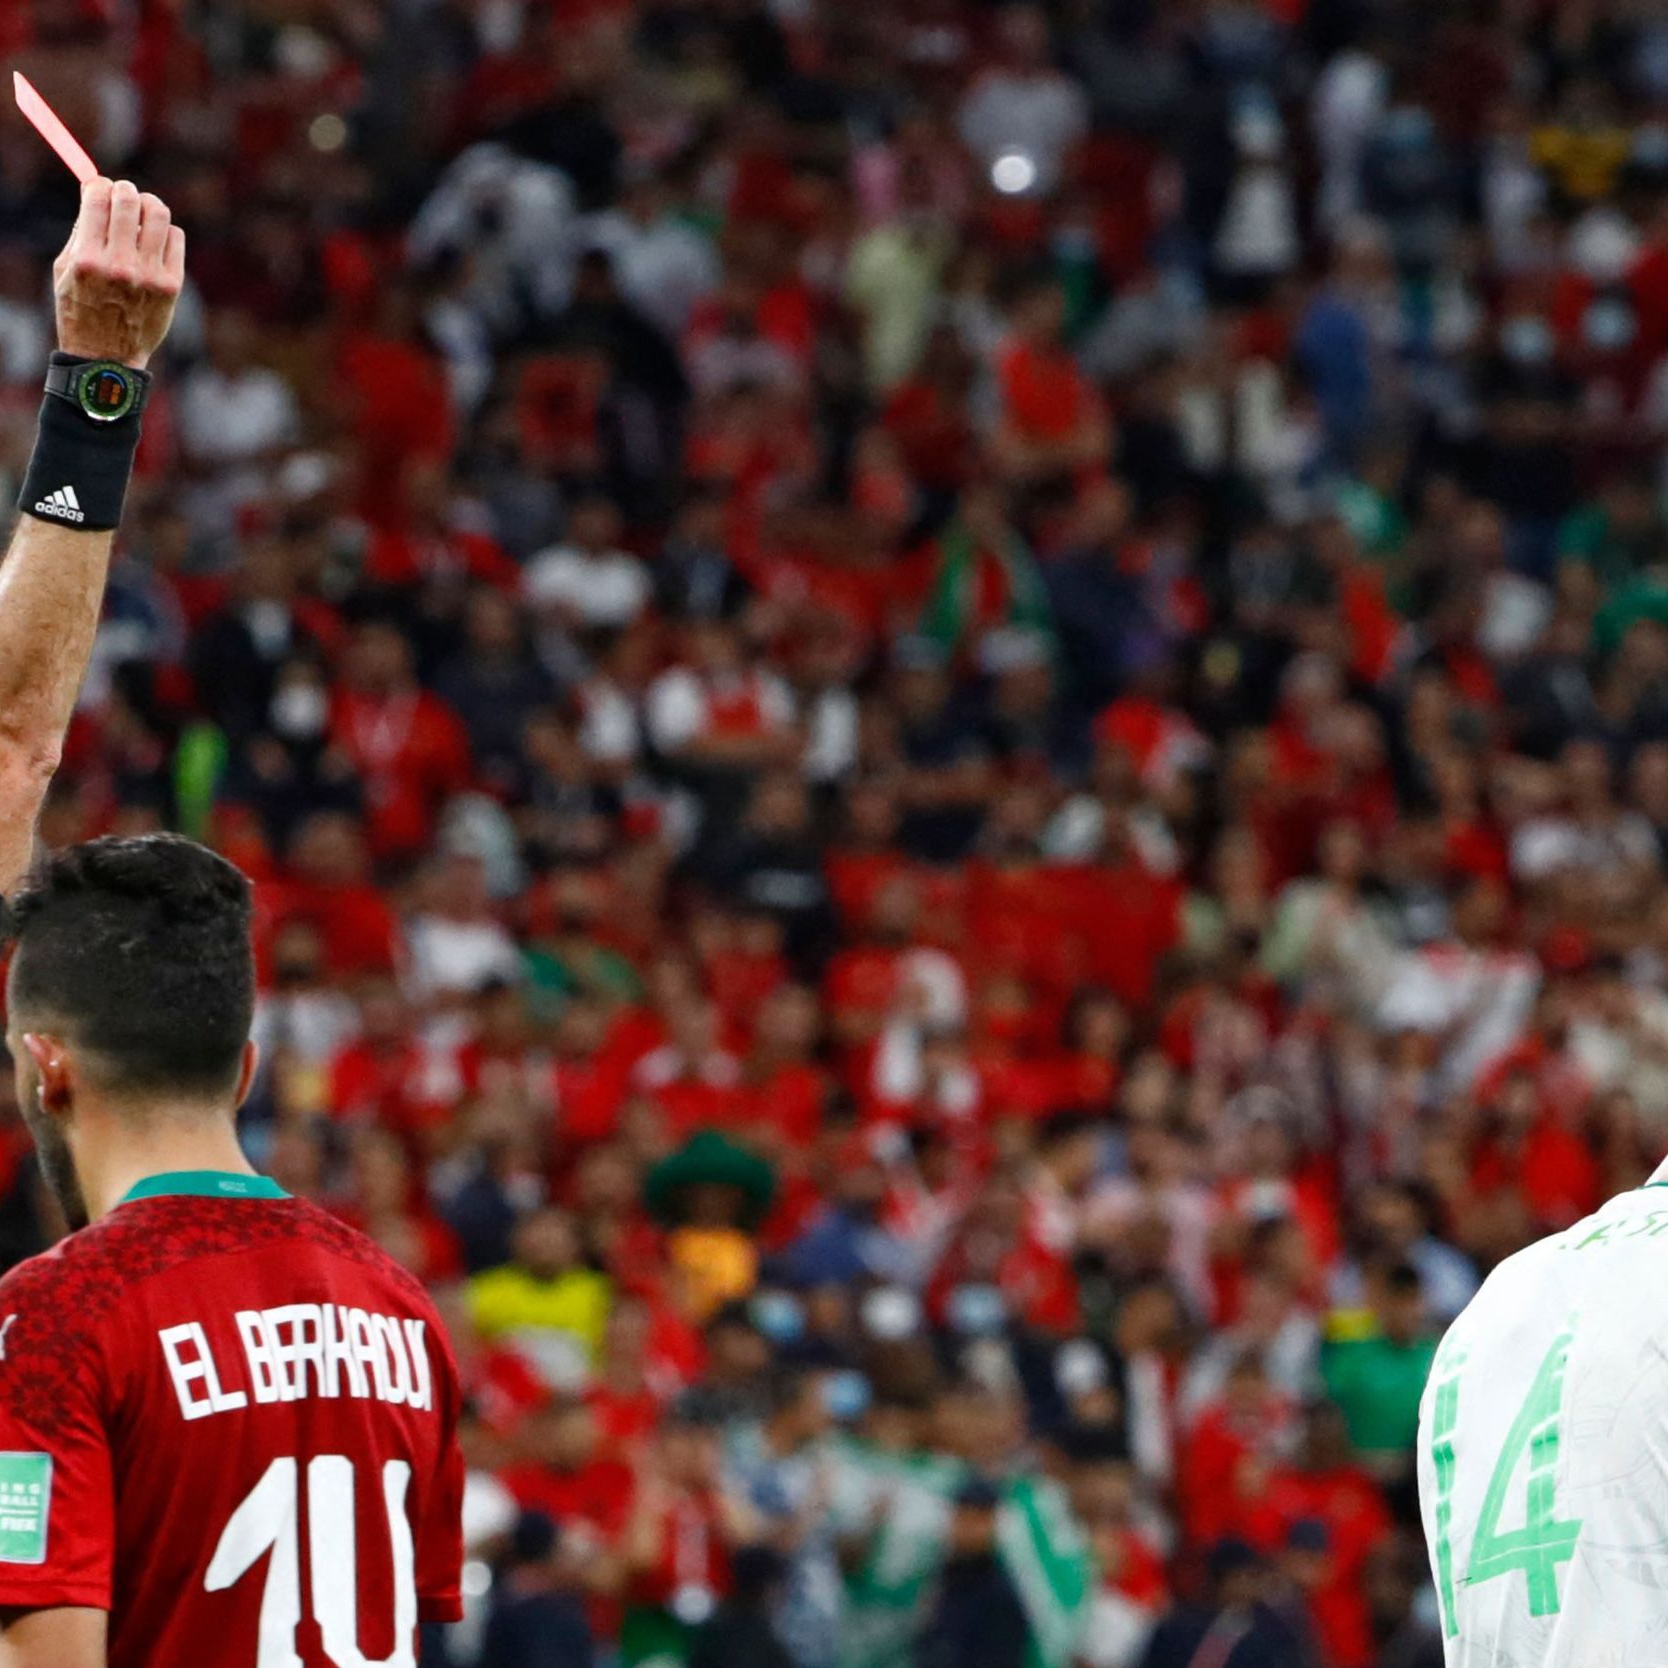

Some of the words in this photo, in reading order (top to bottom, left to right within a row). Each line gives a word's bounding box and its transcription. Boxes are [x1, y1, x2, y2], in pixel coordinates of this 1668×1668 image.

[35, 501, 84, 523] adidas
[158, 1321, 248, 1421] EL
[234, 1302, 433, 1412] BERKAOUI
[1432, 1312, 1584, 1641] 14
